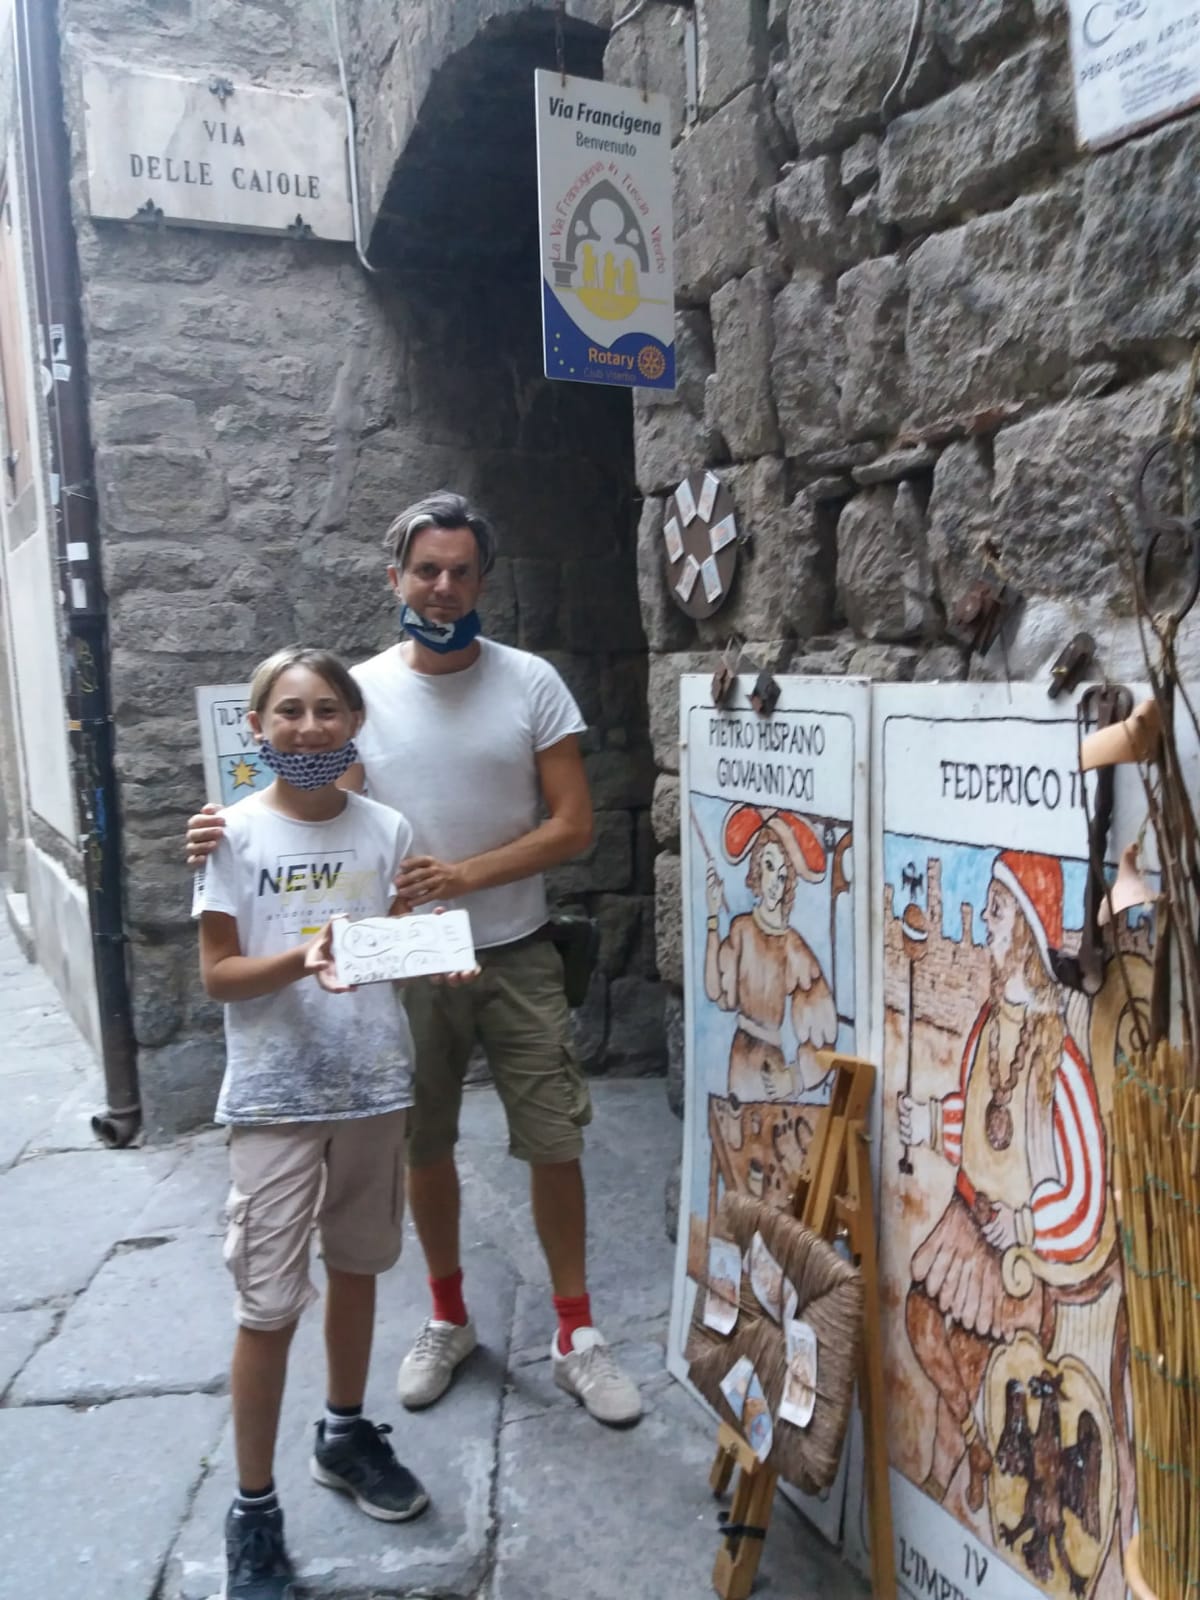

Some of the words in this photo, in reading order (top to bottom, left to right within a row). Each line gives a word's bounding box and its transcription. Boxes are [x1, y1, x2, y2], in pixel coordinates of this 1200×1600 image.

[203, 120, 246, 147] VIA
[549, 97, 574, 119] Via
[577, 103, 661, 136] Francigena
[576, 131, 637, 157] Benvenuto
[130, 153, 213, 186] DELLE
[232, 167, 320, 199] CAIOLE
[588, 347, 634, 370] Rotary
[709, 718, 755, 749] PIETRO
[756, 721, 826, 756] HISPANO
[717, 757, 784, 797] GIOVANNI
[940, 760, 1061, 809] FEDERICO
[258, 862, 344, 897] NEW
